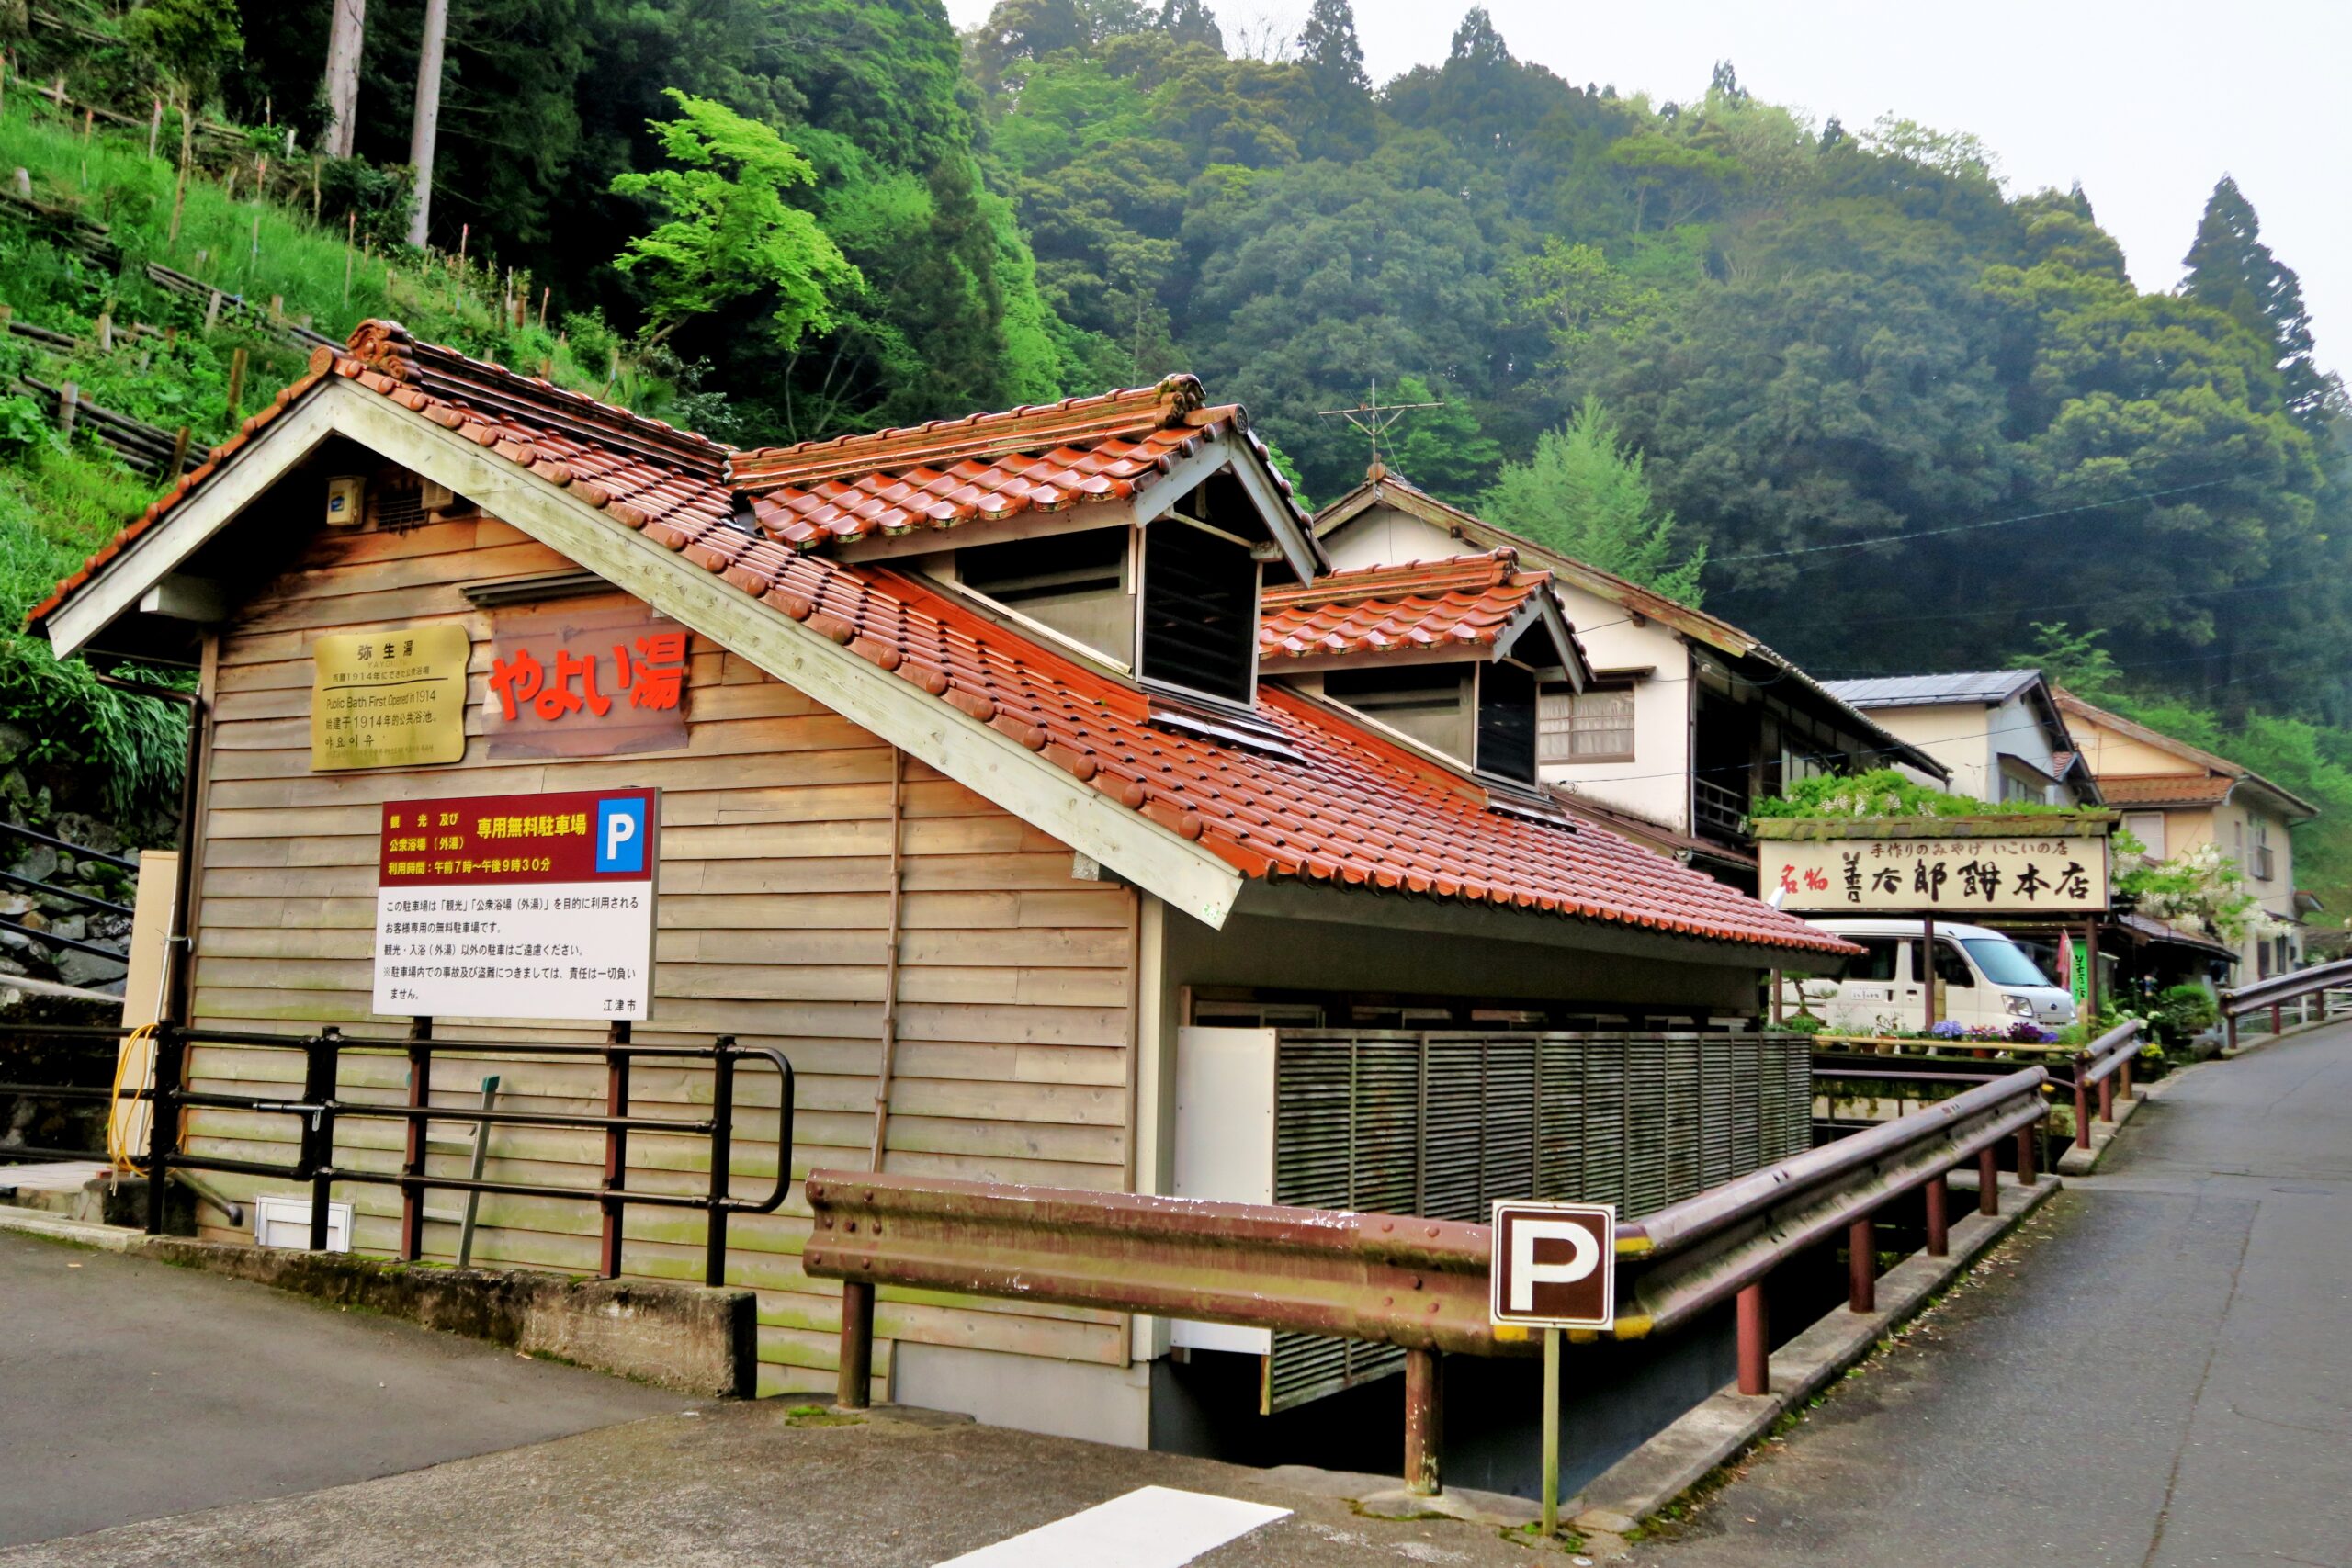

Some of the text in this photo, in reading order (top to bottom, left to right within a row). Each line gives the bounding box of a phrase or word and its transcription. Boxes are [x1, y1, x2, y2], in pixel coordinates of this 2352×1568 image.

[357, 640, 413, 660] 弥生湯
[489, 632, 686, 721] やよい湯
[327, 690, 436, 709] Public Bath First Opened in 1914
[477, 814, 586, 839] 専用無料駐車場
[607, 814, 635, 860] P
[1780, 863, 1829, 894] 名物
[385, 922, 501, 934] お客様専用の無料駐車場です。
[390, 988, 419, 999] ません。
[603, 999, 636, 1011] 江津市
[1510, 1218, 1600, 1312] P
